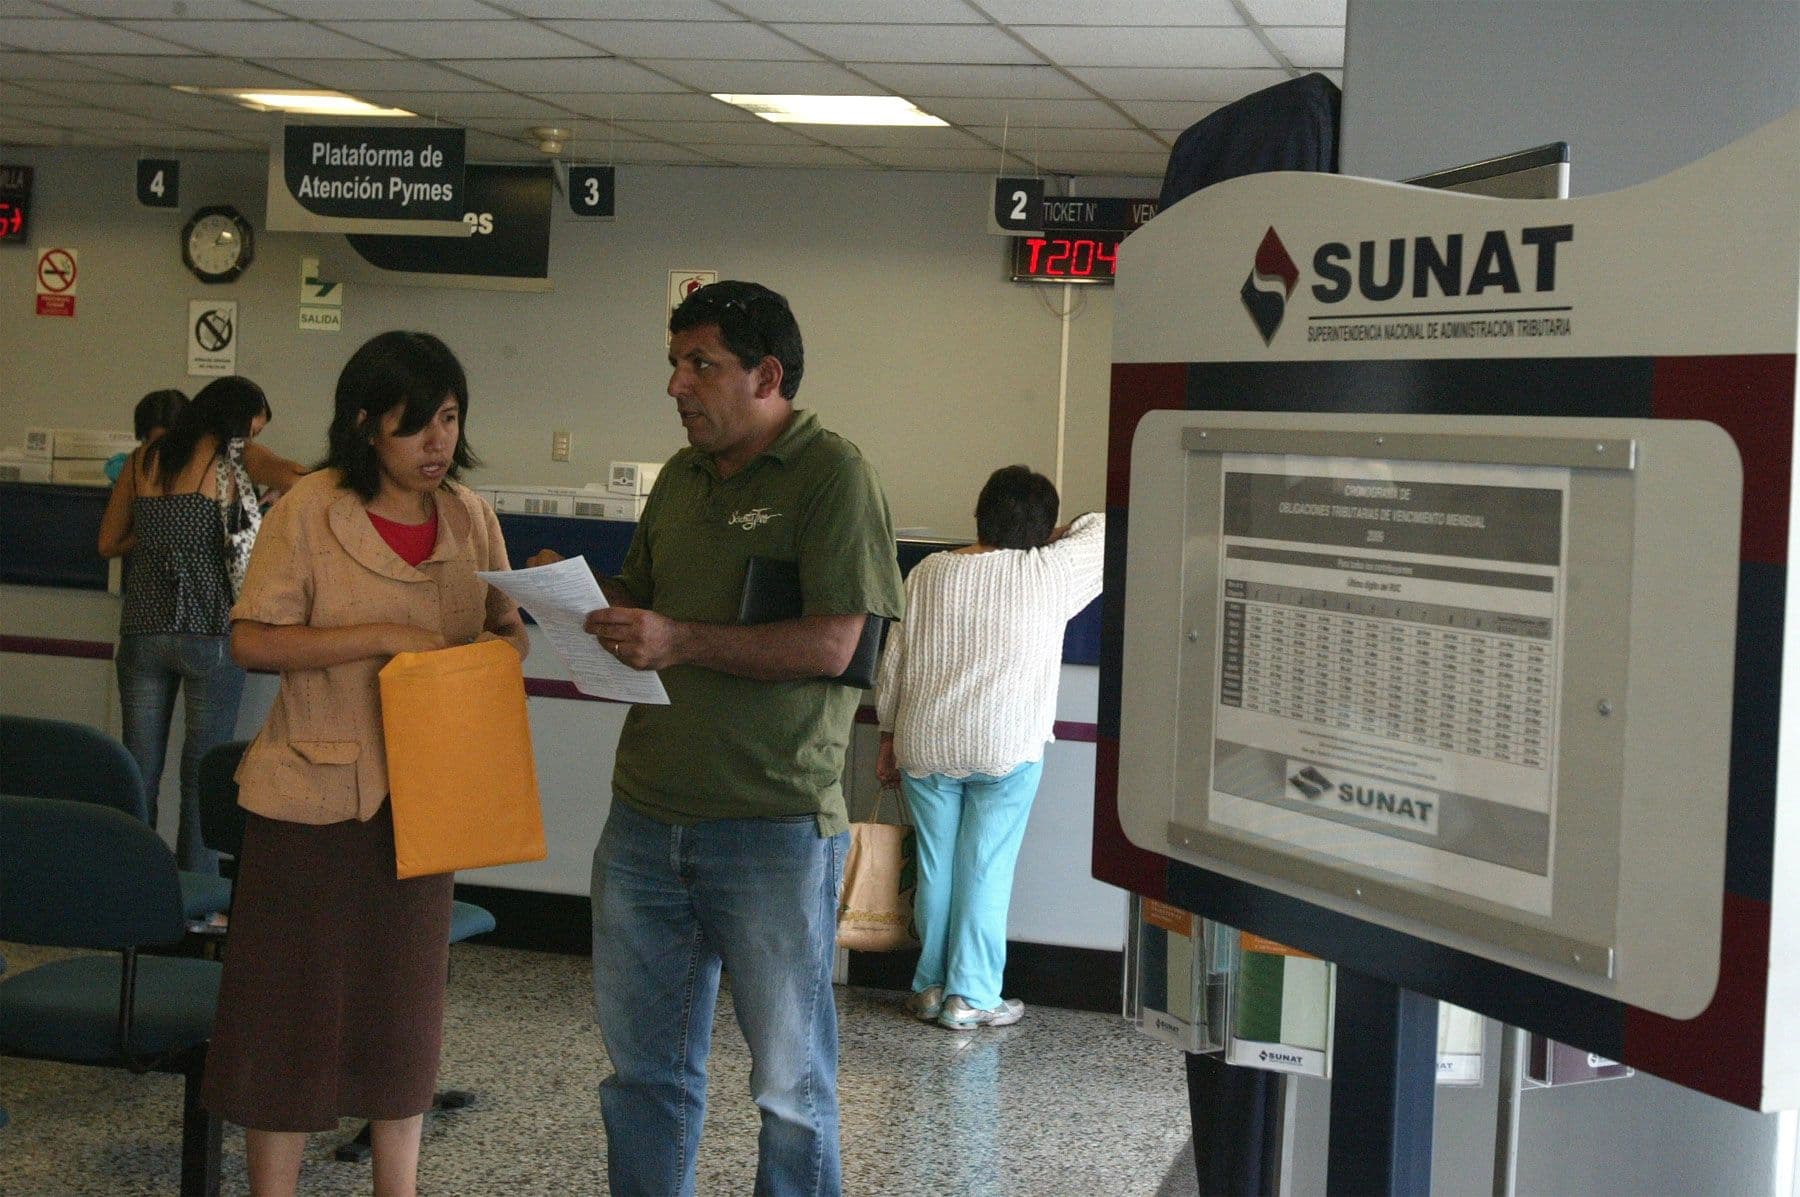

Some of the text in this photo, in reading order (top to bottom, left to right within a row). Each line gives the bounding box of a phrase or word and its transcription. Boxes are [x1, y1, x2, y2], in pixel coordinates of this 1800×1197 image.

[312, 142, 443, 168] Plataforma de
[150, 170, 165, 198] 4
[298, 174, 453, 206] Atención Pymes
[584, 177, 600, 206] 3
[1009, 190, 1028, 220] 2
[1043, 202, 1084, 222] TICKET
[1311, 223, 1575, 304] SUNAT
[301, 314, 339, 325] SALIDA
[1308, 324, 1382, 342] SUPERINTENDENCIA
[1384, 323, 1425, 340] NACIONAL
[1427, 322, 1440, 340] DE
[1516, 317, 1571, 337] TRIBUTARIA
[1337, 782, 1434, 822] SUNAT
[1268, 1052, 1304, 1063] SUNAT
